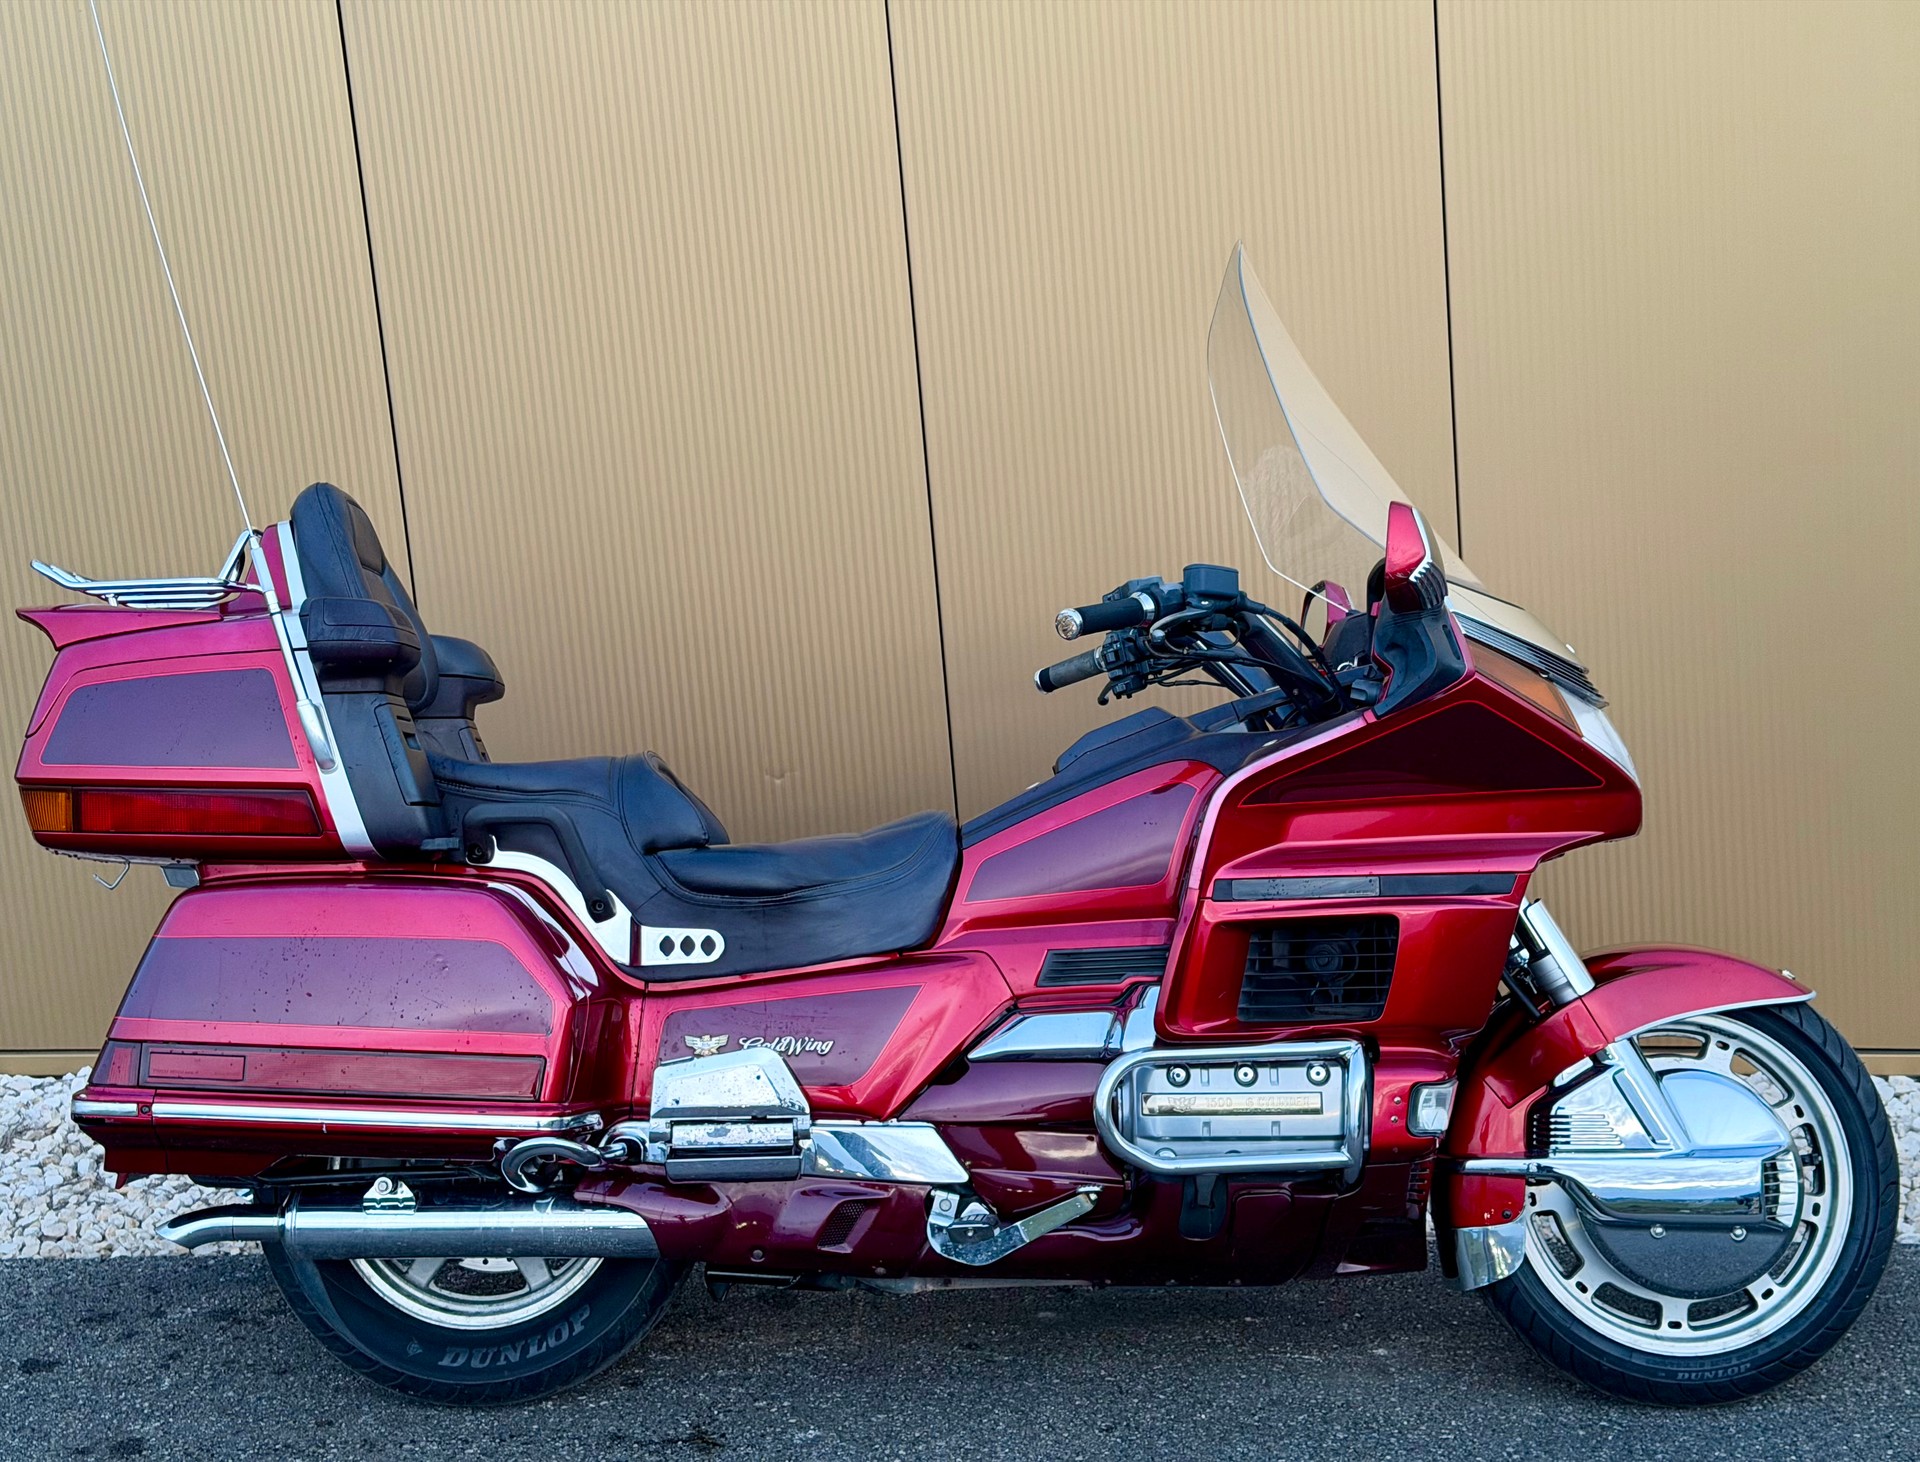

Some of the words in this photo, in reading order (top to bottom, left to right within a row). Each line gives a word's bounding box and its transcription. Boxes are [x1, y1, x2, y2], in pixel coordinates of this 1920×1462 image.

[1205, 1097, 1233, 1108] 1500
[438, 1304, 591, 1369] DUNLOP
[1676, 1363, 1751, 1380] DUNLOP
